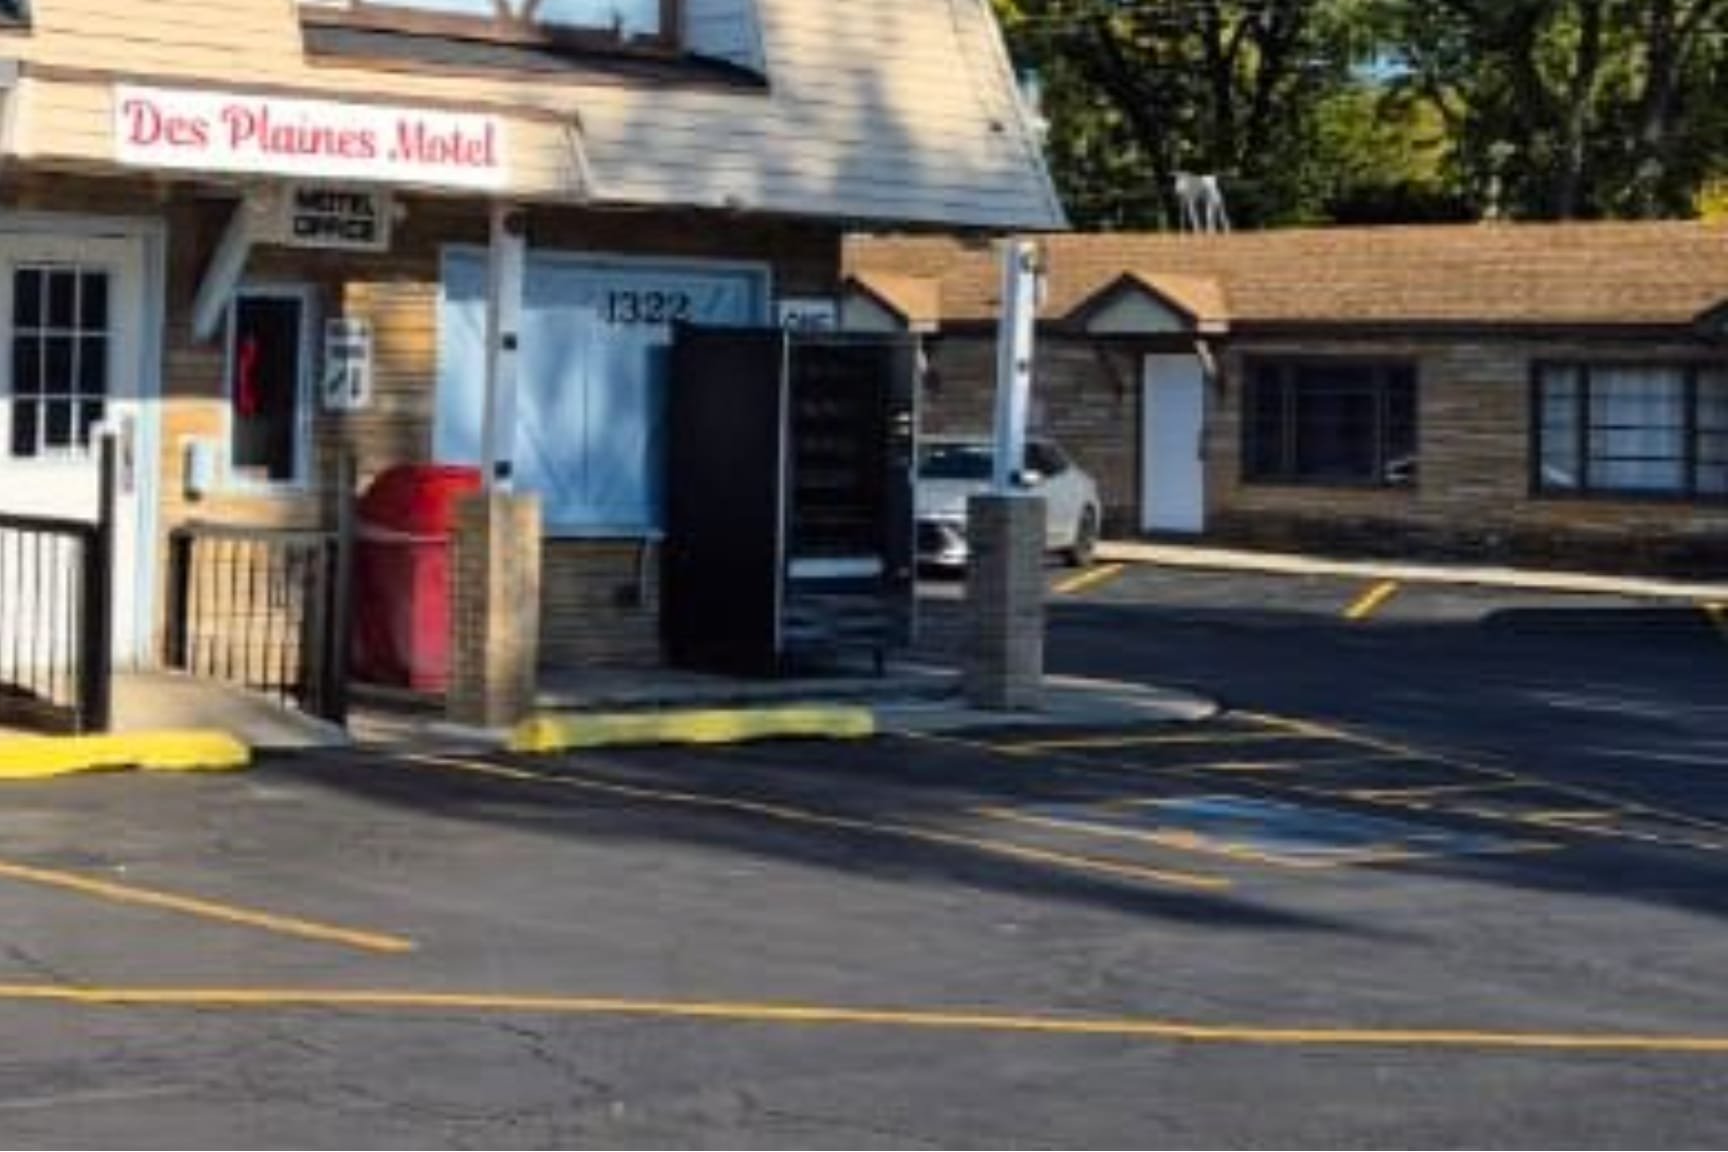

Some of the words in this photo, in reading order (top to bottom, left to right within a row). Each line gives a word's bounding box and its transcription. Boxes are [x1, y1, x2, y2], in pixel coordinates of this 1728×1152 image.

[123, 99, 210, 147] Des
[221, 103, 376, 159] Plaines
[387, 118, 498, 168] Motel
[605, 289, 692, 324] 1322
